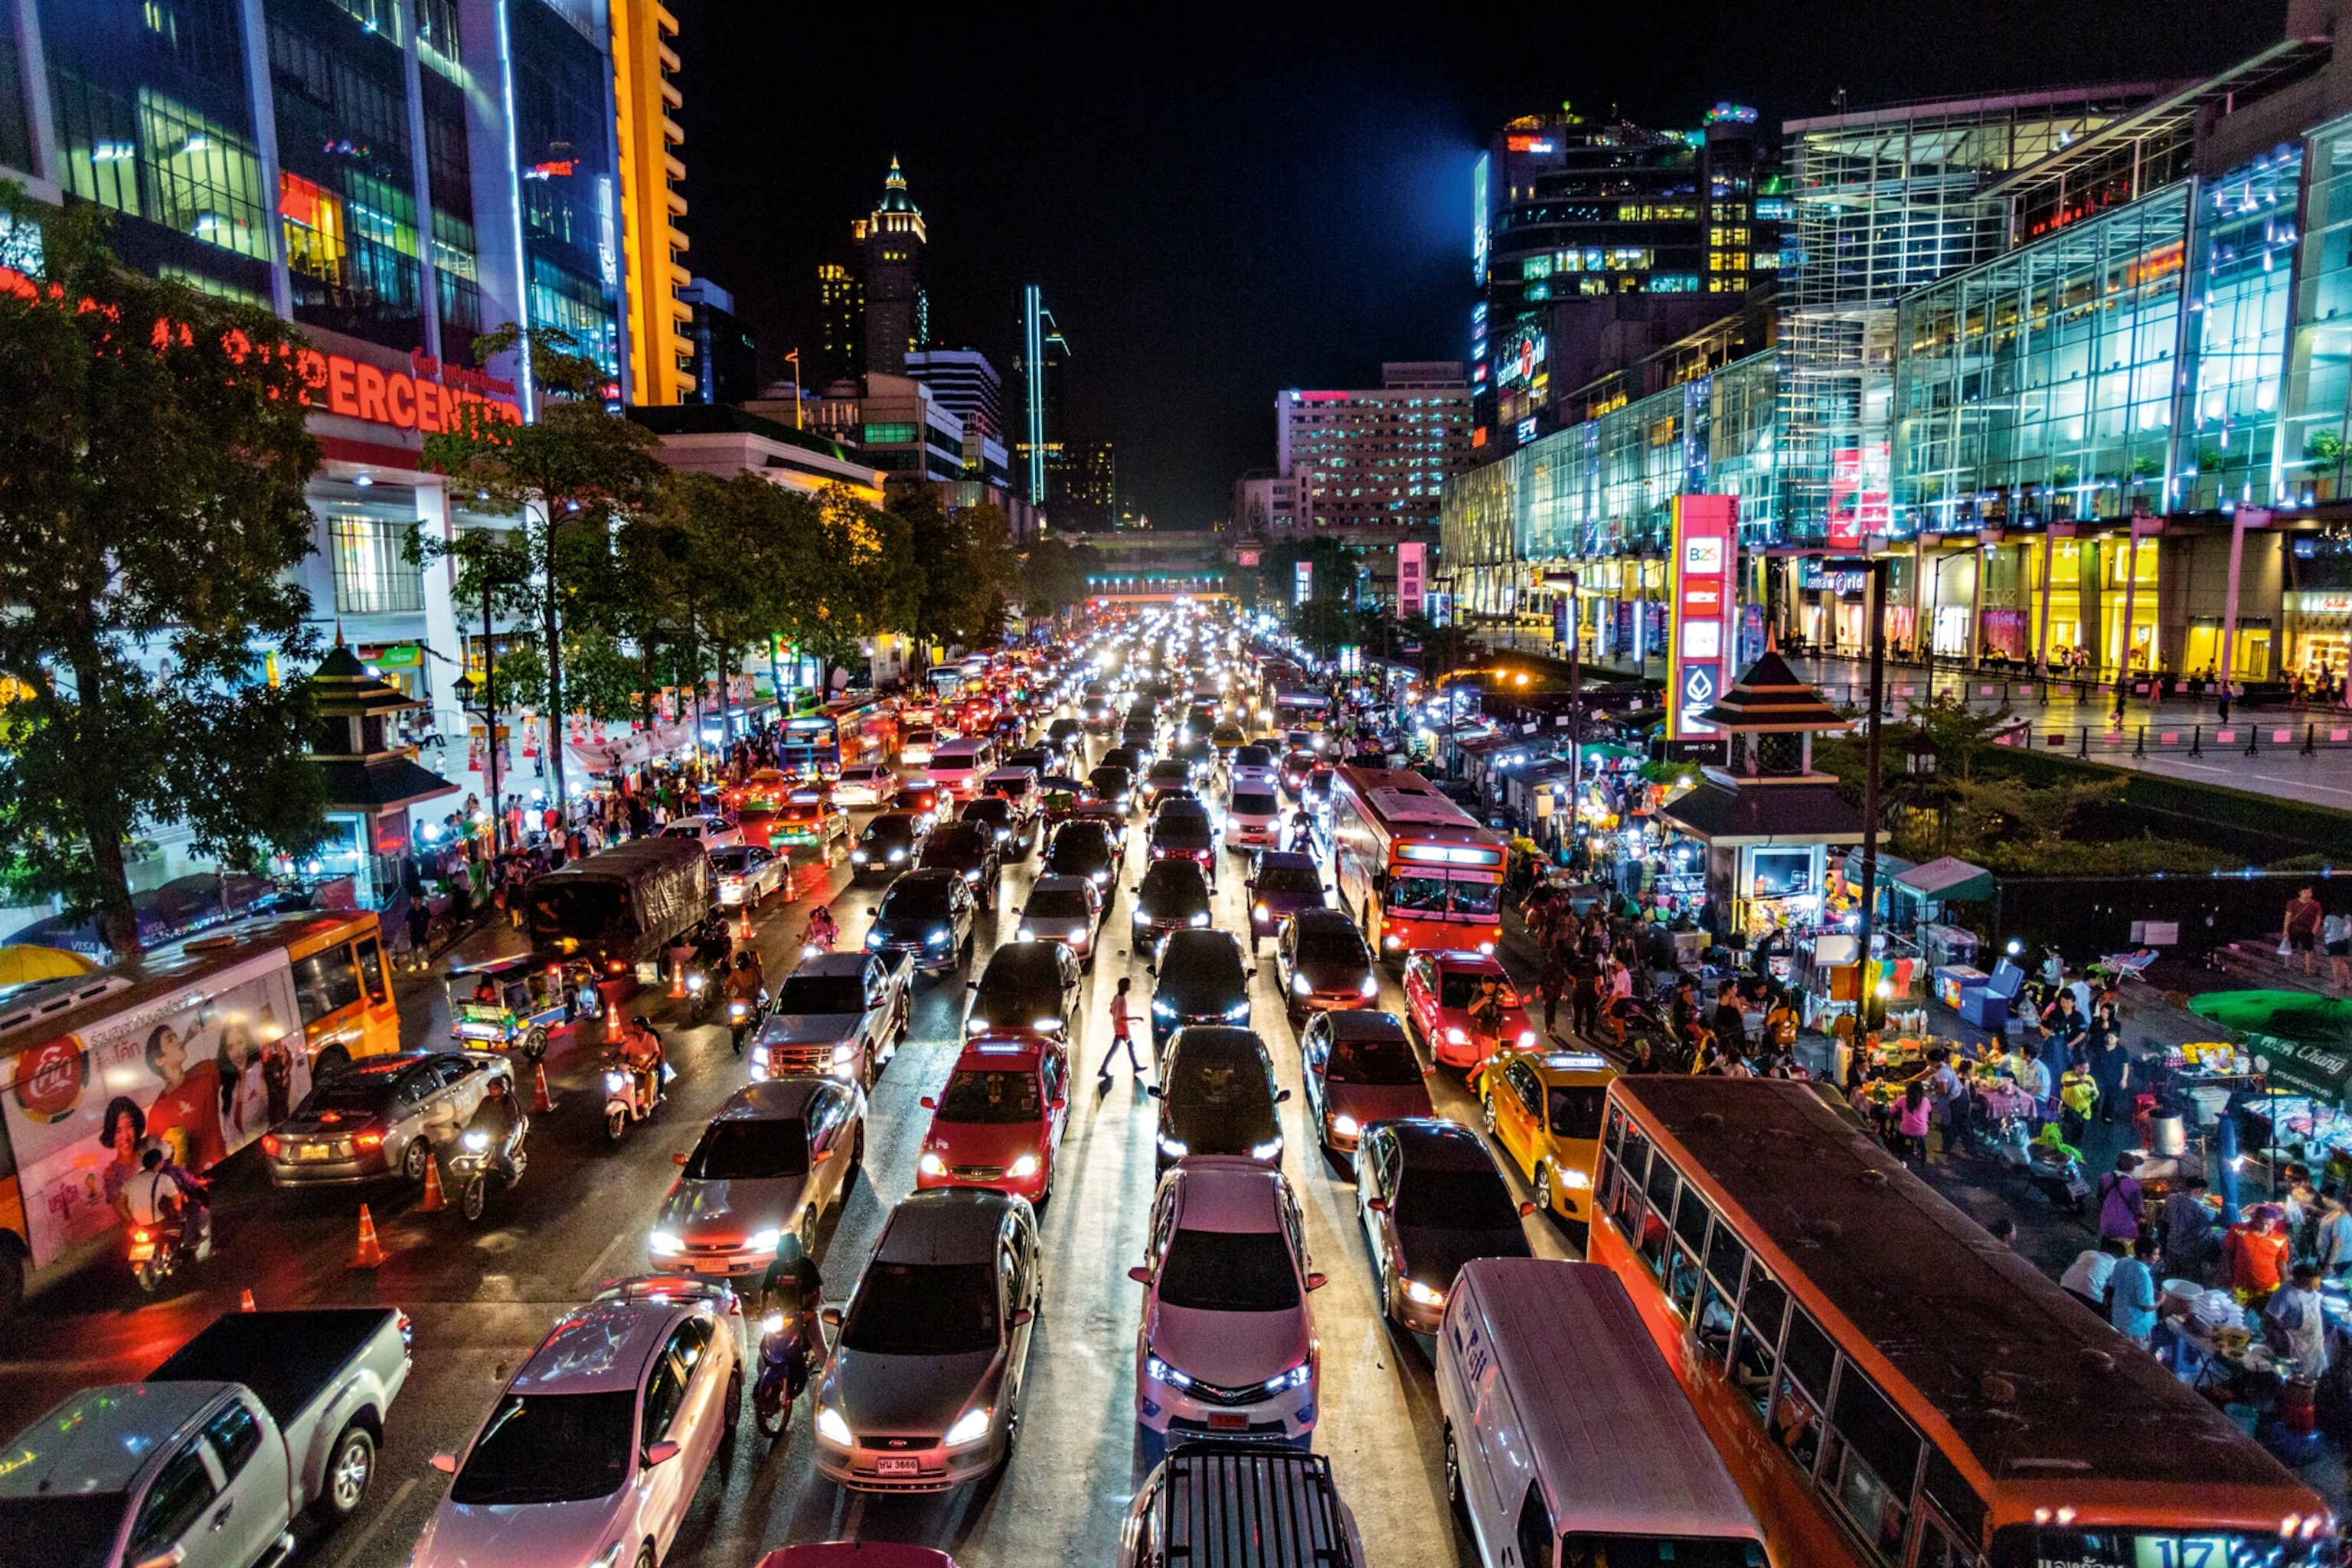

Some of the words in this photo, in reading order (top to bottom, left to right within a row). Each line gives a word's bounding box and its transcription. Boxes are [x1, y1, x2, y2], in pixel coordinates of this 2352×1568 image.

[1690, 547, 1717, 561] B2S
[1808, 570, 1864, 596] centralworld
[390, 652, 413, 662] Welcome
[144, 921, 166, 934] VISA
[70, 940, 96, 952] VISA
[2297, 1045, 2345, 1075] Chang
[2155, 1540, 2215, 1568] 17
